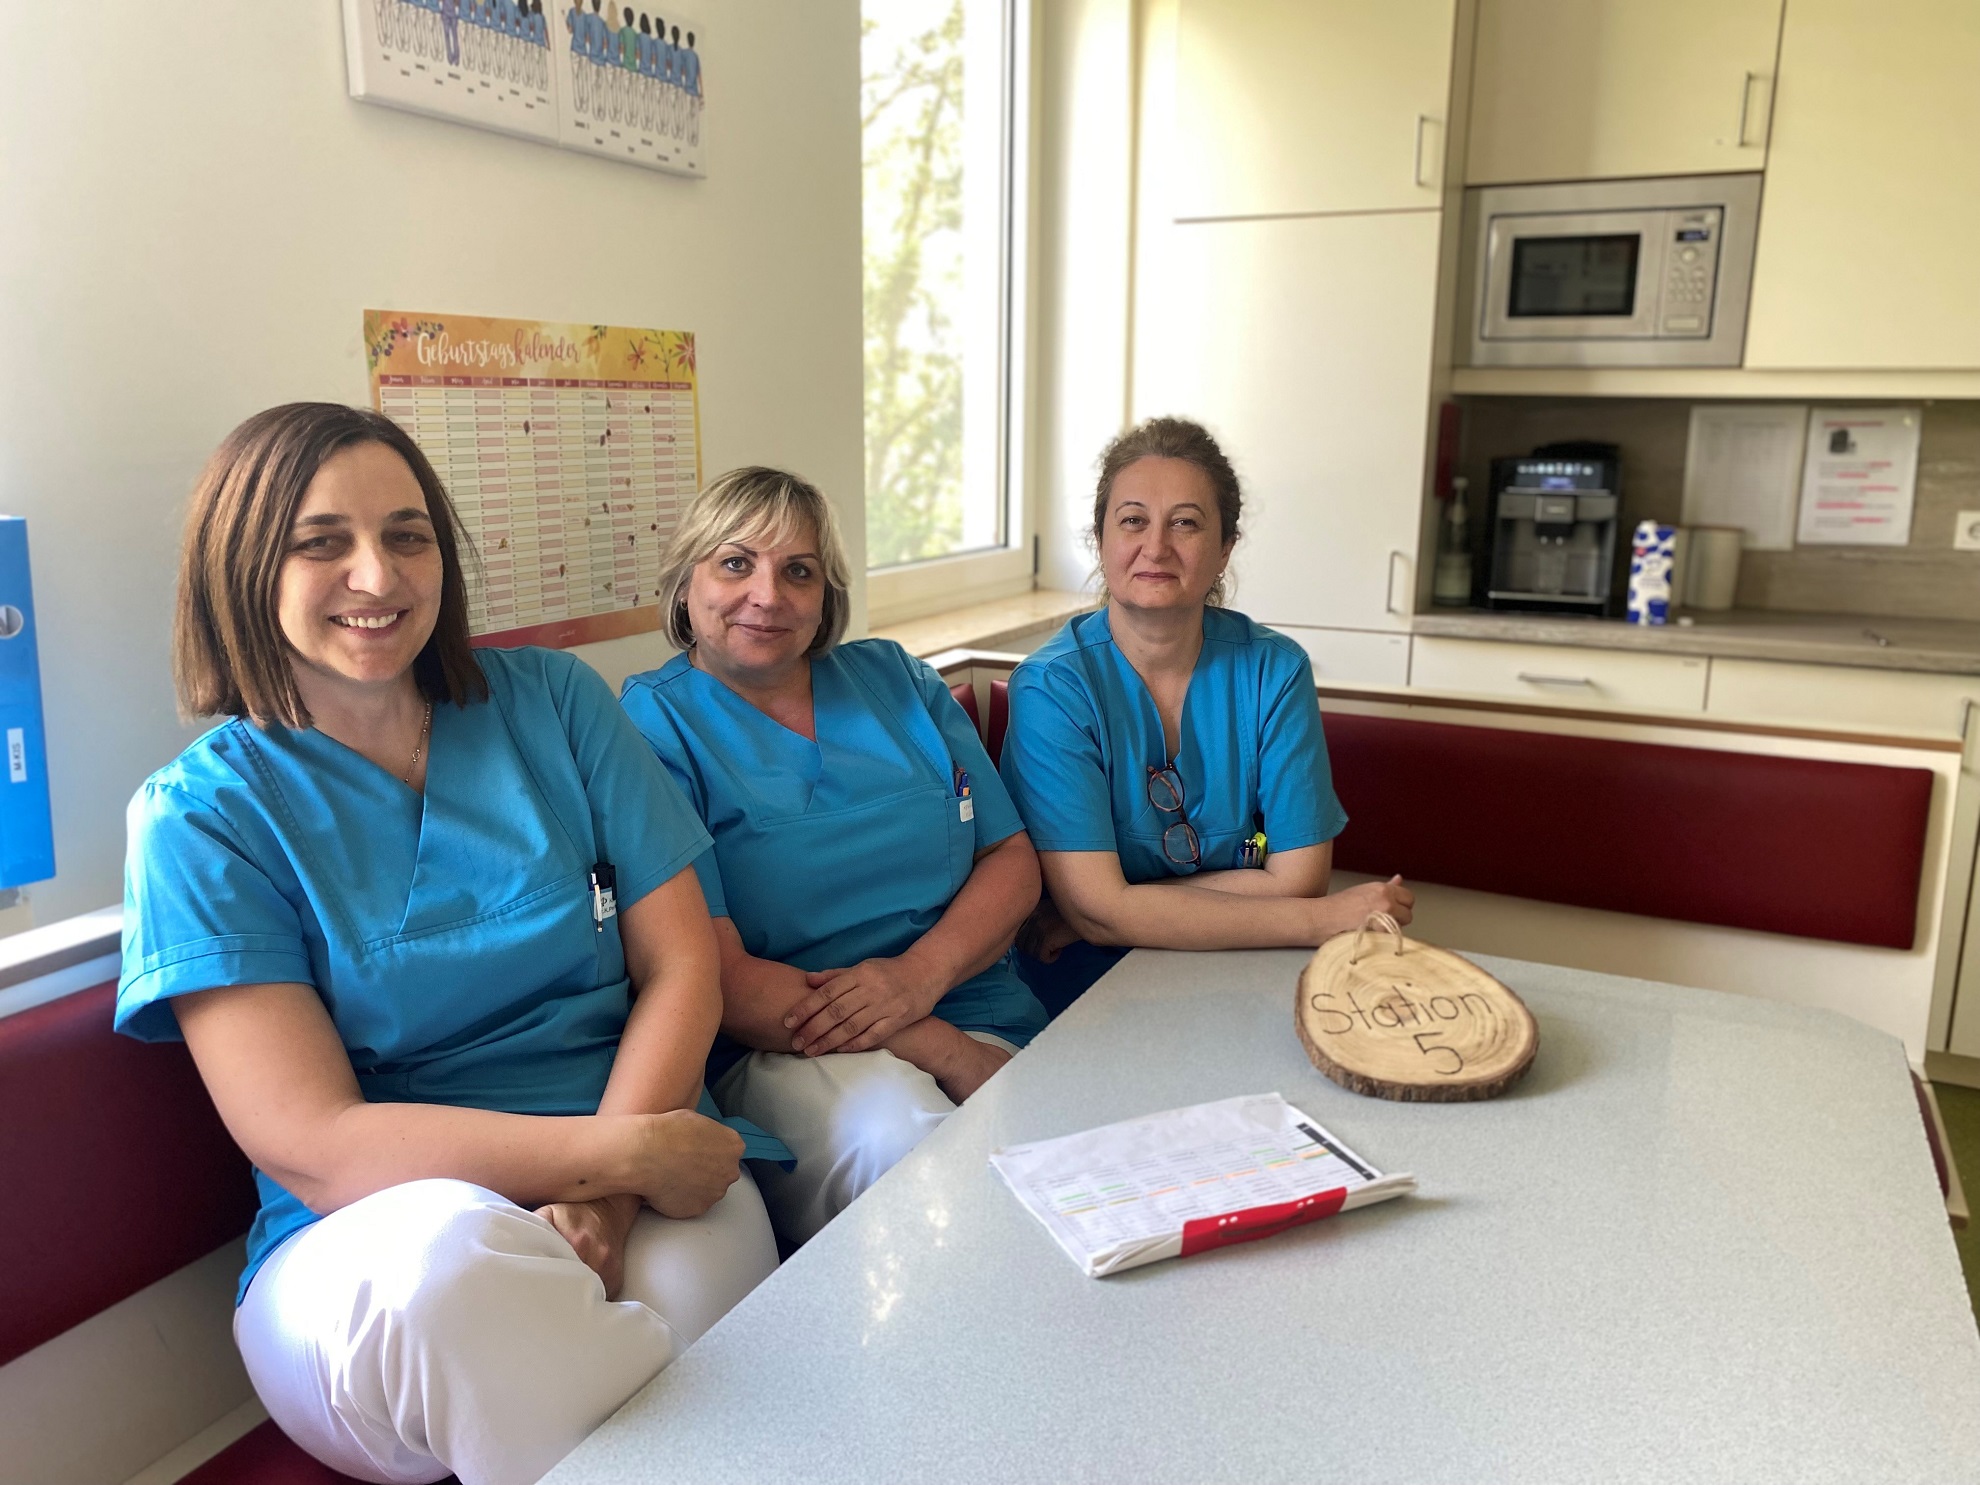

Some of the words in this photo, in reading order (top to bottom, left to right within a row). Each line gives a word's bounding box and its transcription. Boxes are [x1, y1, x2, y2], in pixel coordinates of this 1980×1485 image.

[417, 328, 581, 369] Geburtstagskalender
[1311, 982, 1493, 1034] Station
[1413, 1031, 1464, 1075] 5
